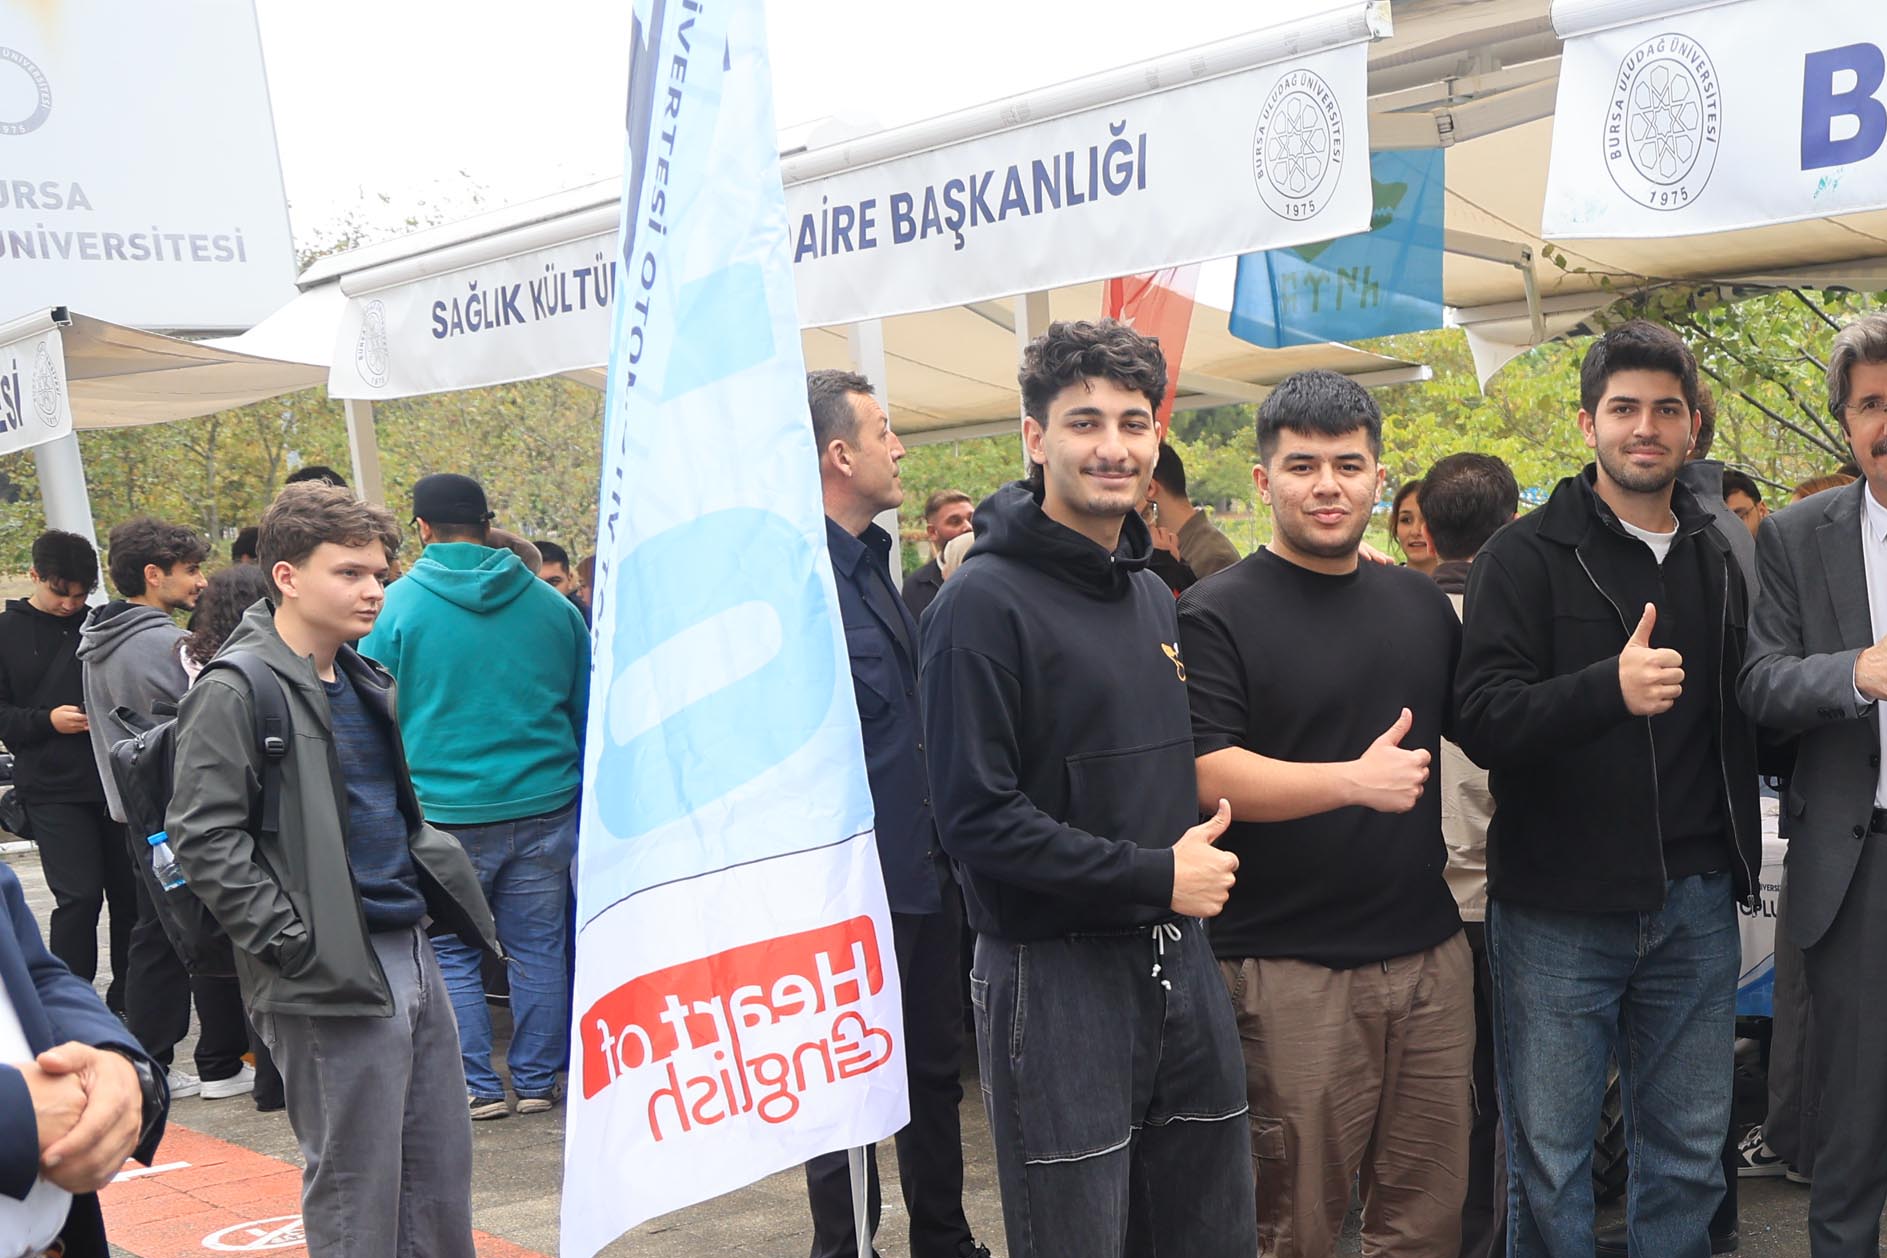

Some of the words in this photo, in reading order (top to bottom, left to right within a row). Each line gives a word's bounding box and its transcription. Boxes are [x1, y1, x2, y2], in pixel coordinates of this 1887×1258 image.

[1608, 99, 1625, 160] BURSA
[1619, 37, 1666, 92] ULUDAĞ
[1670, 36, 1717, 144] ÜNİVERSİTESİ
[1255, 126, 1266, 180] BURSA
[787, 195, 877, 263] AİRE
[890, 119, 1147, 251] BAŞKANLIĞI
[1286, 200, 1316, 217] 1975
[1650, 186, 1689, 207] 1975
[432, 279, 526, 340] SAĞLIK
